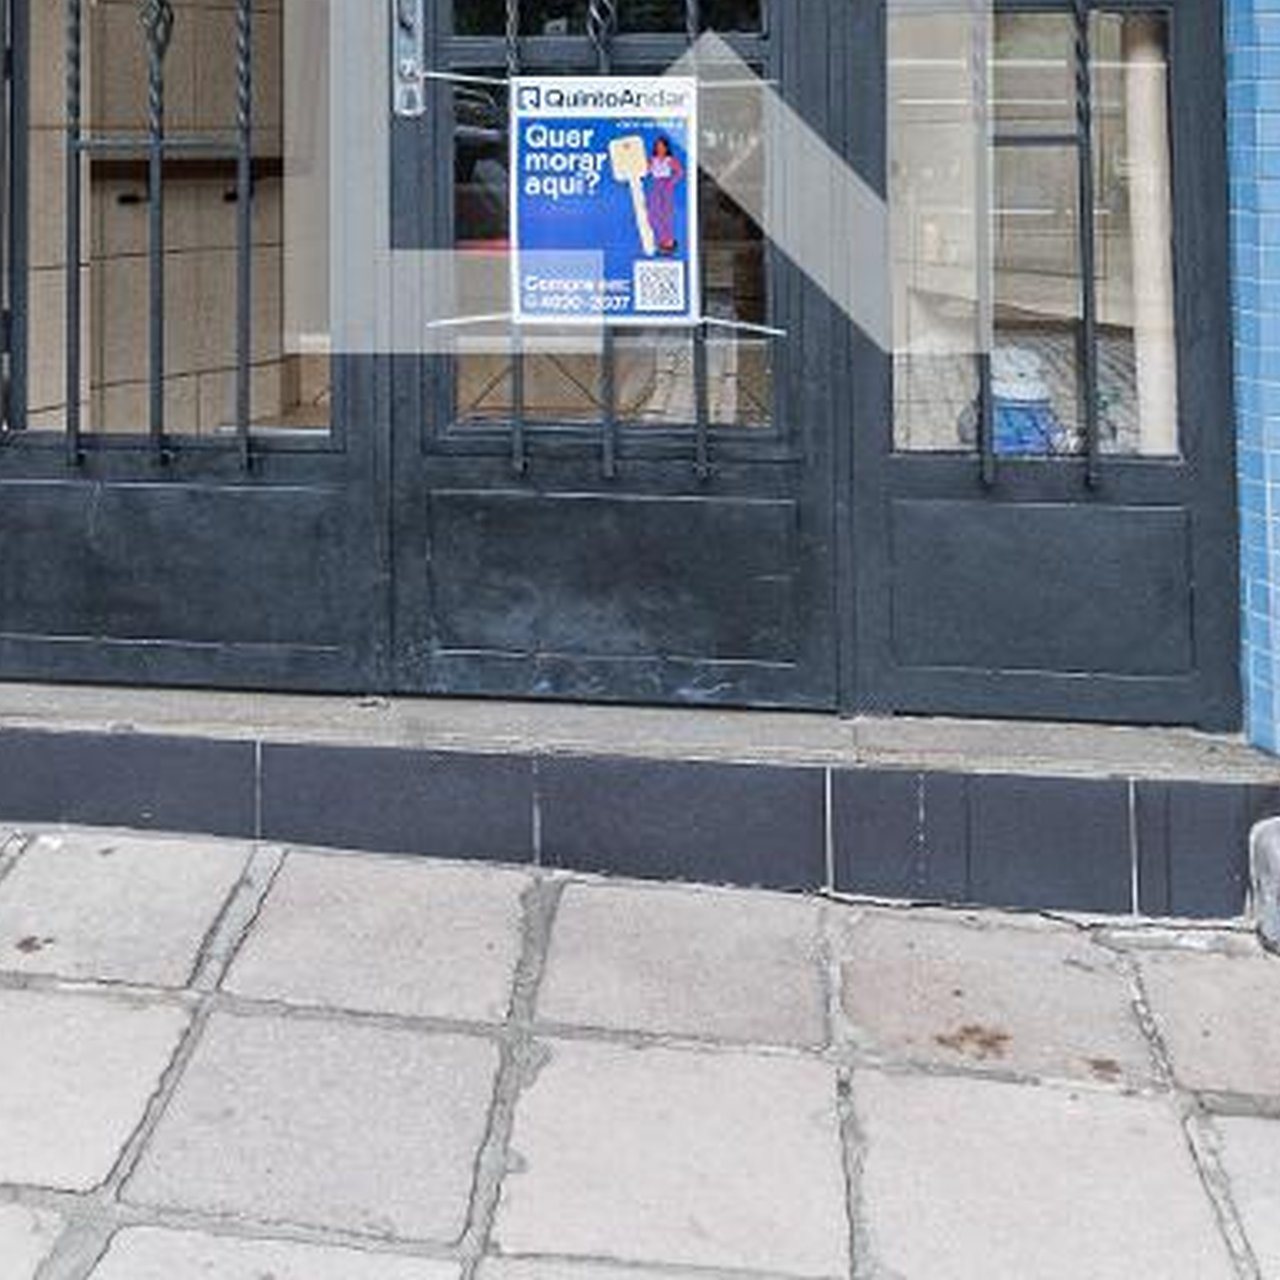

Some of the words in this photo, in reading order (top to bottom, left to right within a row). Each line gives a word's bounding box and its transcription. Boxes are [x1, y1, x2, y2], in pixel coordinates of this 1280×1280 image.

[545, 88, 686, 108] QuintoAndar
[525, 124, 594, 148] Quer
[525, 152, 608, 171] morar
[524, 172, 601, 200] aqui?
